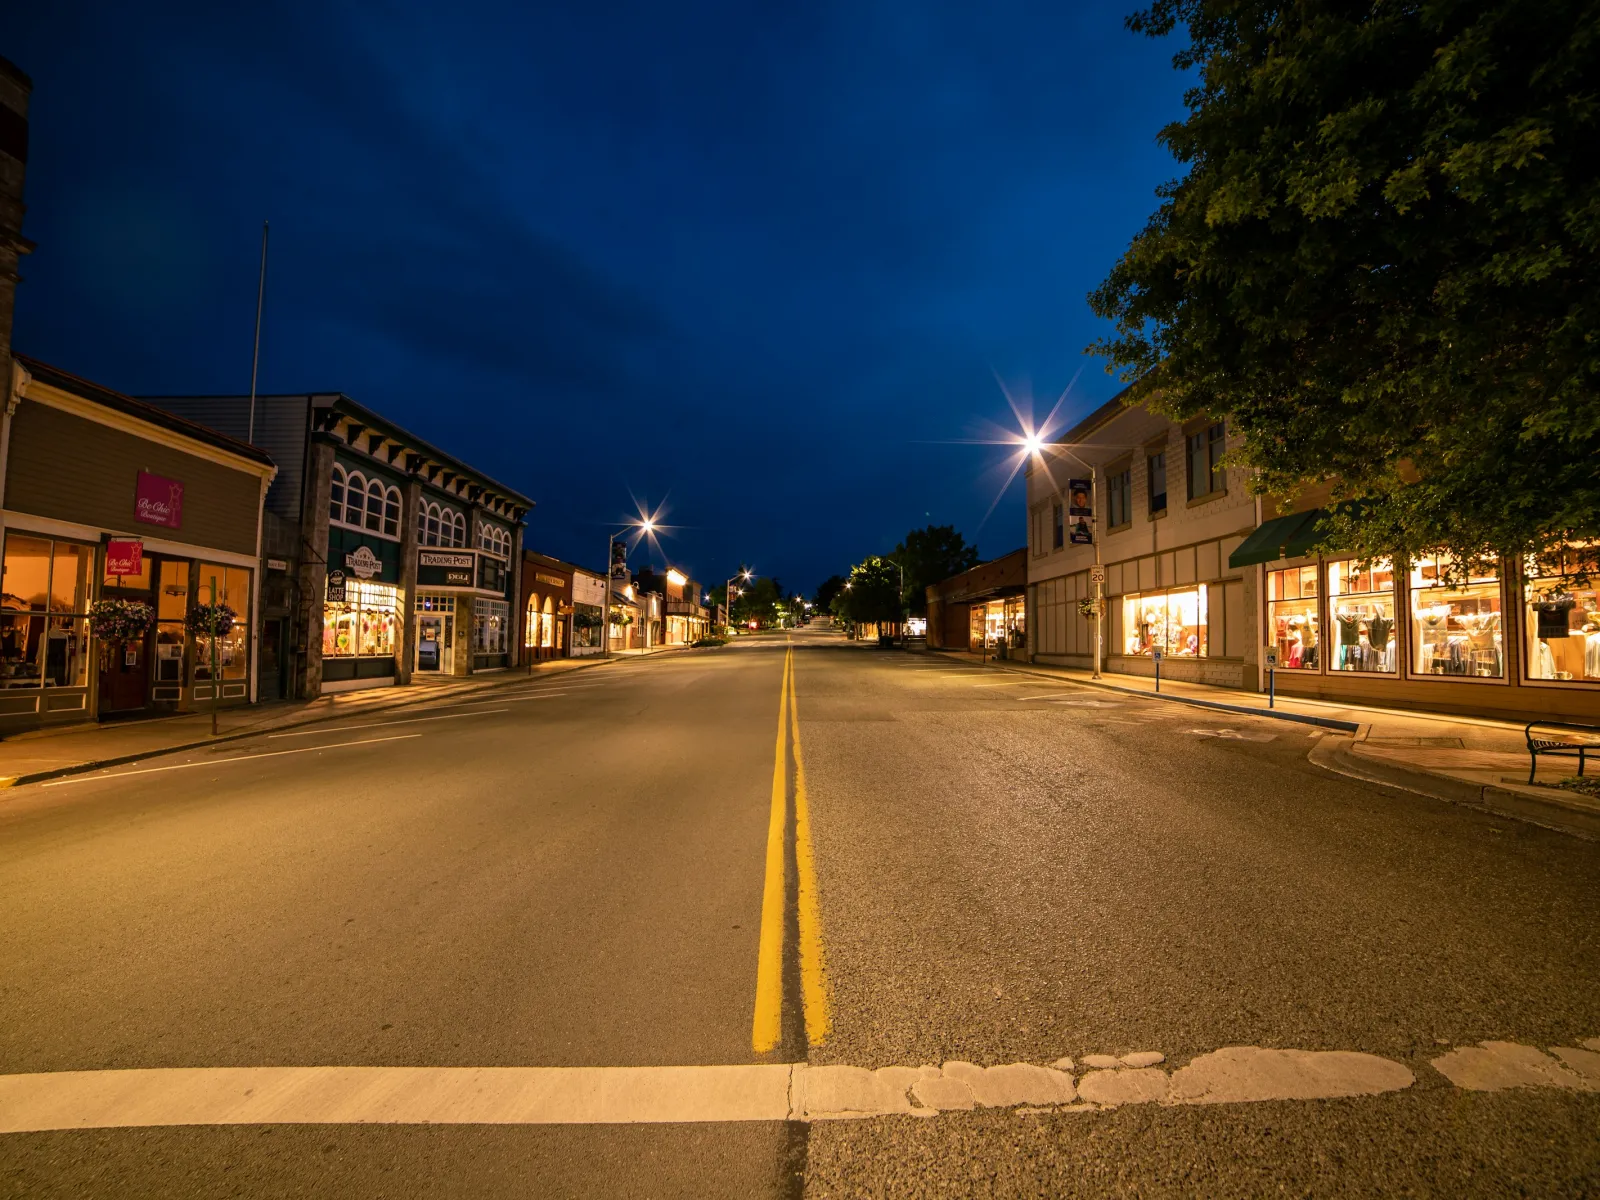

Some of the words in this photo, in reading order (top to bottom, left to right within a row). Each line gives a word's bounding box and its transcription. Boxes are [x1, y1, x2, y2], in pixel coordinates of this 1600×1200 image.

[138, 498, 152, 510] Be
[153, 501, 170, 513] Chic
[140, 510, 167, 522] Boutique
[348, 557, 369, 568] TRADING
[369, 561, 382, 571] POST
[423, 554, 452, 564] TRADING
[453, 556, 471, 565] POST
[1092, 574, 1104, 582] 20
[328, 587, 345, 595] LATTE
